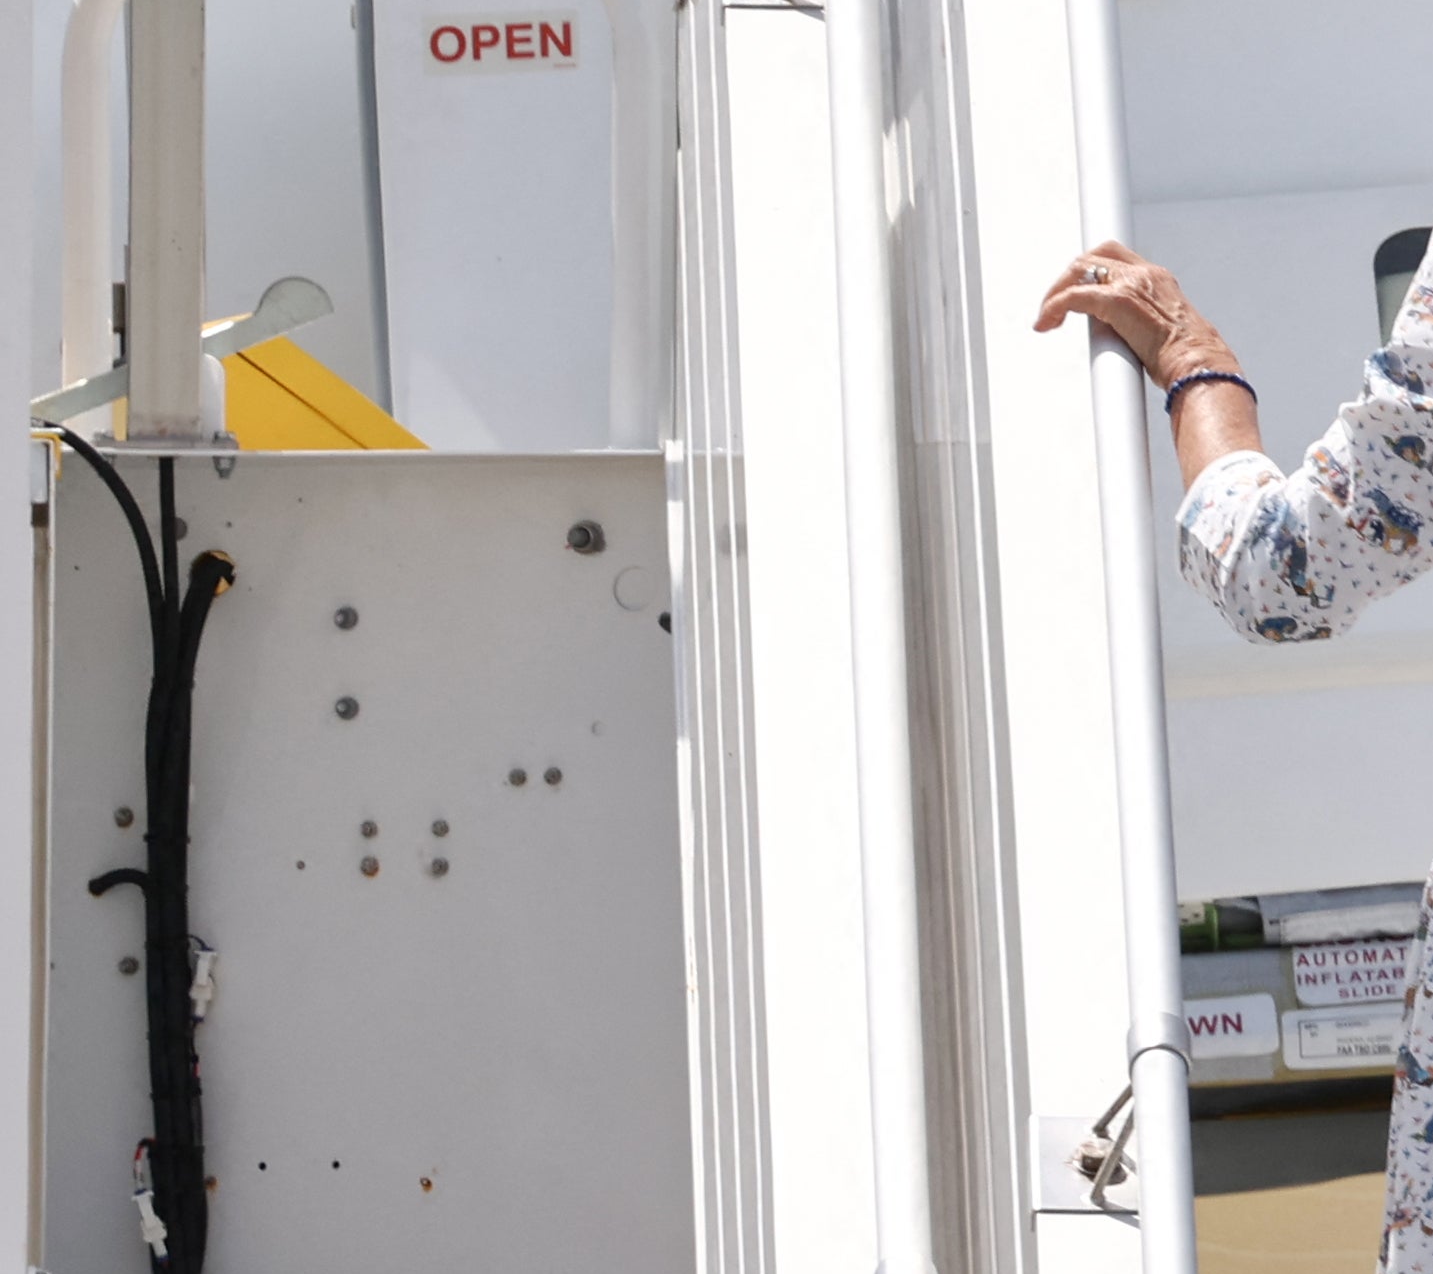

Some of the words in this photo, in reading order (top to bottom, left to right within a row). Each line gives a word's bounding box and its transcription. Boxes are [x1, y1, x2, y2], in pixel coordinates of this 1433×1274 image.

[430, 20, 573, 63] OPEN
[1296, 946, 1408, 968] AUTOMAT
[1338, 985, 1397, 999] SLIDE
